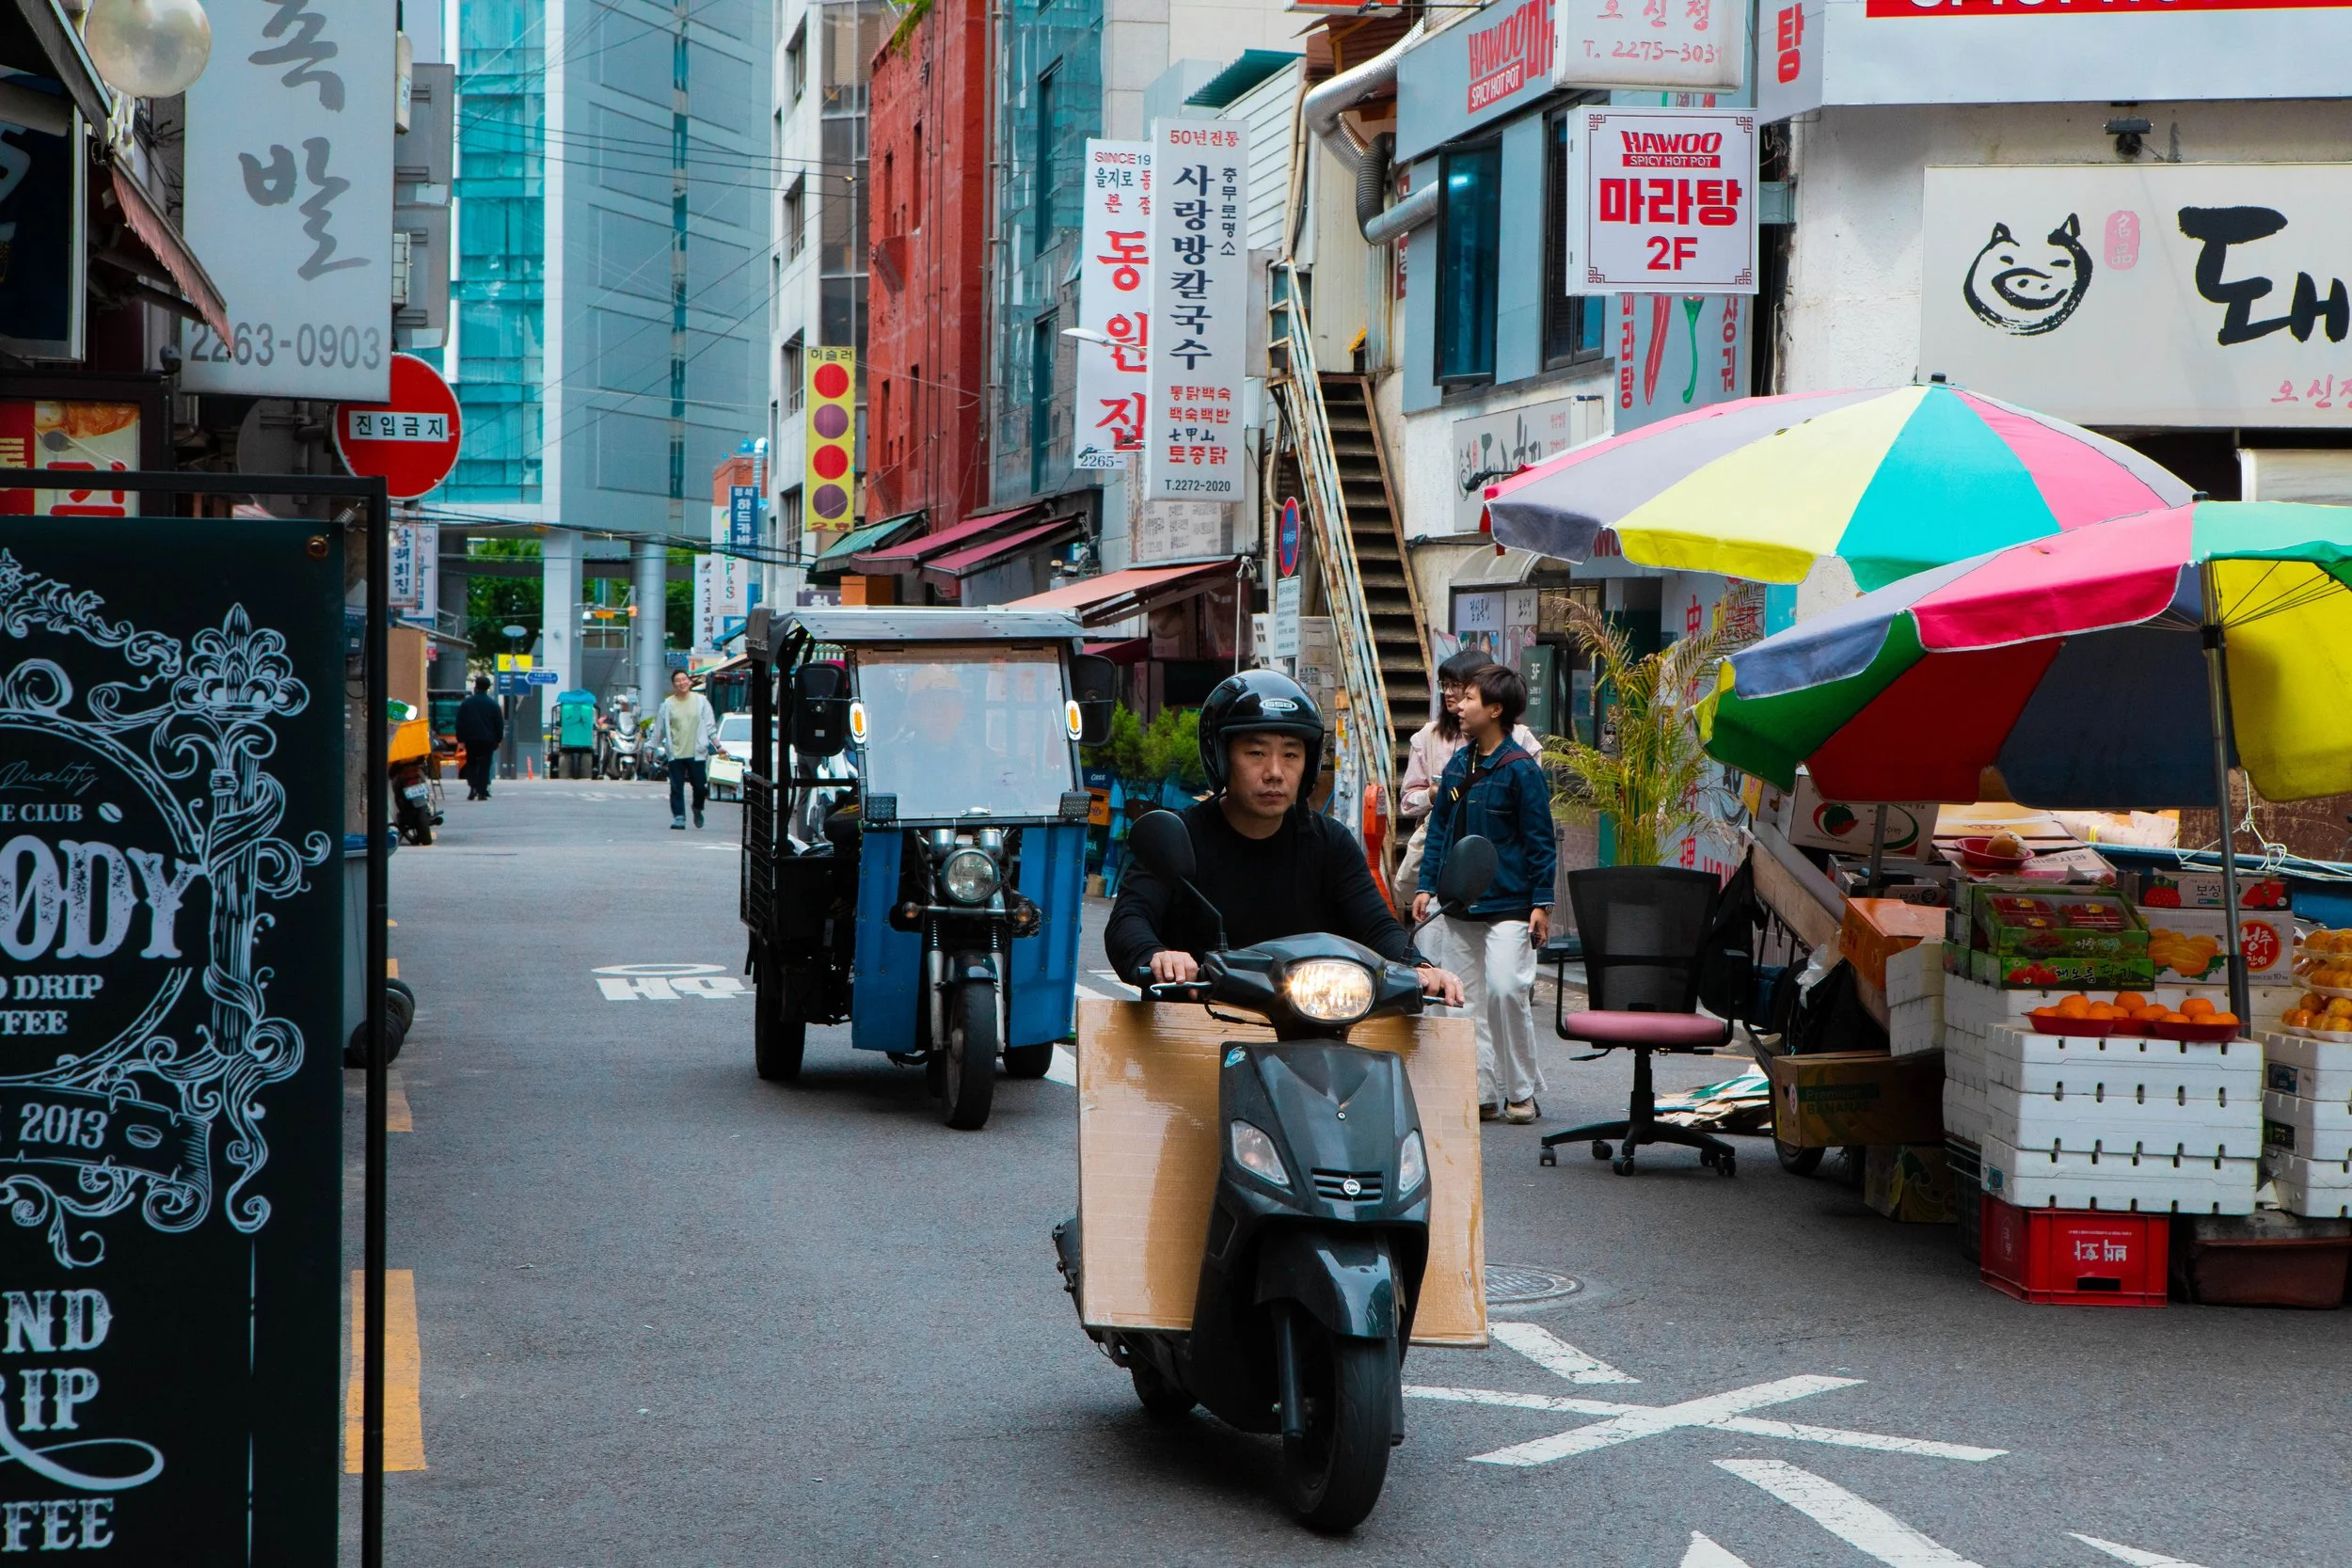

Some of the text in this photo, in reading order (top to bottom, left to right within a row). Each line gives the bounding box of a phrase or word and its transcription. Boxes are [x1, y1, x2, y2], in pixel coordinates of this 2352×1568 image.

[1468, 3, 1527, 81] HAWOO
[1582, 40, 1601, 59] T.
[1776, 3, 1805, 85] 탕
[1471, 64, 1520, 109] SPICY HOT POT
[1621, 131, 1722, 154] HAWOO
[1629, 156, 1712, 167] SPICY HOT POT
[1094, 166, 1134, 189] 을지로
[1219, 167, 1238, 257] 충무로명소
[1599, 178, 1742, 227] 마라탕
[1646, 236, 1698, 271] 2F
[1168, 164, 1216, 371] 사랑방칼국수
[1095, 230, 1150, 455] 동원집
[1169, 386, 1232, 403] 통닭백숙
[357, 414, 444, 439] 진입금지
[1168, 406, 1231, 424] 백숙백반
[1168, 427, 1216, 442] 七甲山
[1168, 445, 1229, 465] 토종닭
[1165, 479, 1232, 492] T.2272-2020
[20, 803, 83, 822] CLUB
[2197, 883, 2221, 898] 보성
[13, 974, 104, 1000] DRIP
[19, 1103, 109, 1148] 2013
[3, 1290, 115, 1354] ND
[2, 1498, 116, 1553] FEE
